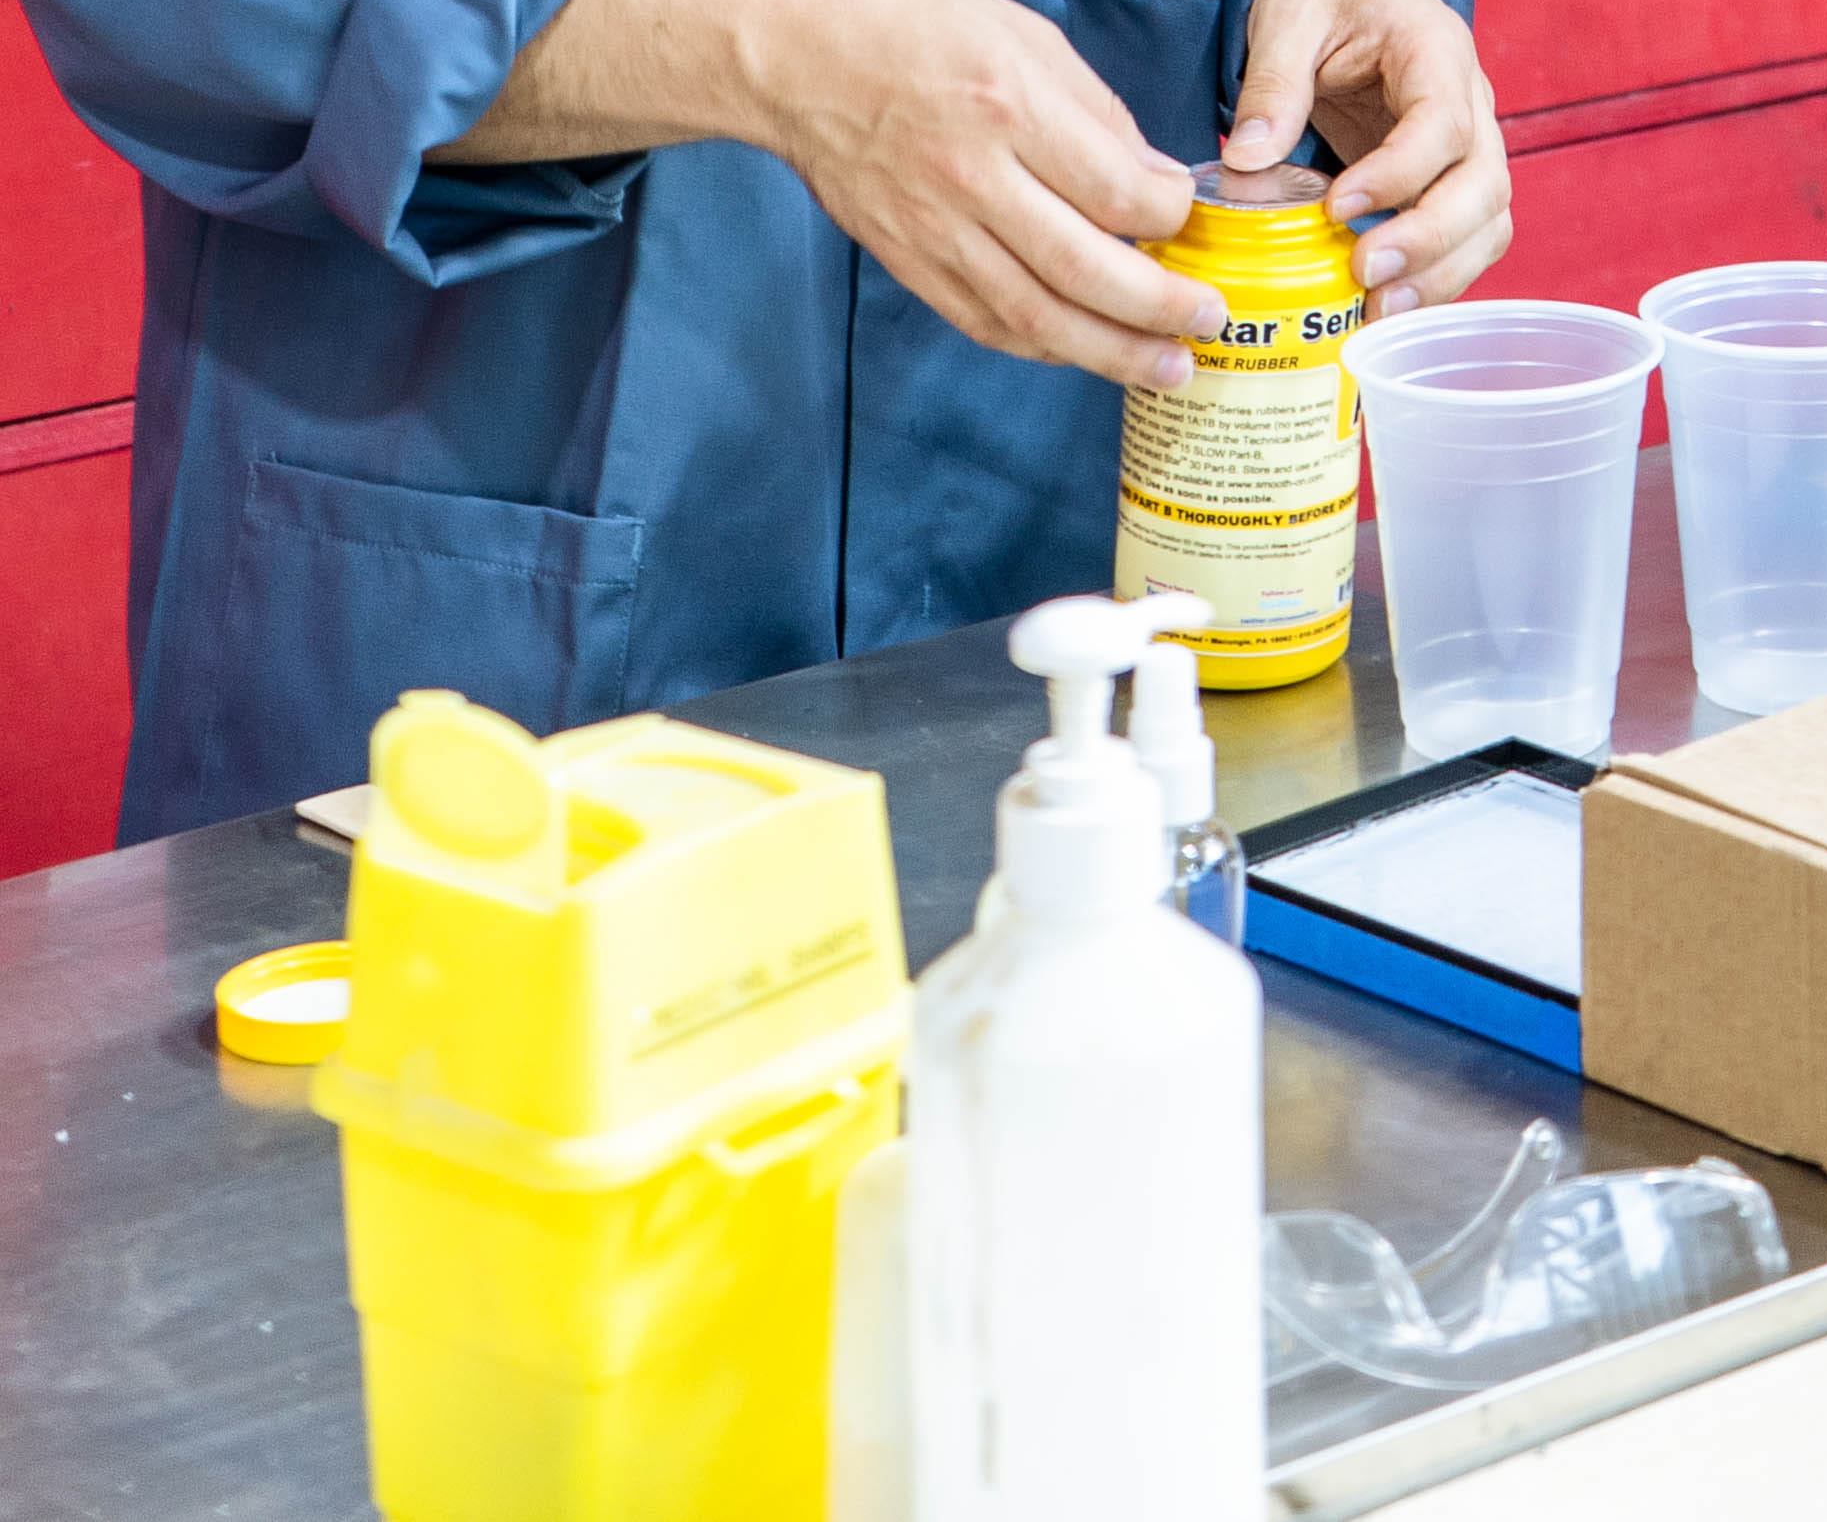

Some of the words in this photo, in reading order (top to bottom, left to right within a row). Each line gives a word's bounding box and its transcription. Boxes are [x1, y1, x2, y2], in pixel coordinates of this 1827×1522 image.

[1234, 356, 1299, 371] RUBBER
[1218, 404, 1252, 416] Series
[1256, 404, 1296, 416] rubbers
[1219, 420, 1230, 431] by
[1233, 421, 1271, 431] volume
[1243, 434, 1291, 445] Technical
[1192, 445, 1226, 458] SLOW
[1177, 488, 1202, 499] soon
[1222, 493, 1275, 505] possible.
[1132, 493, 1160, 512] PART
[1164, 505, 1172, 516] B
[1176, 508, 1284, 526] THOROUGHLY
[1289, 502, 1335, 524] BEFORE
